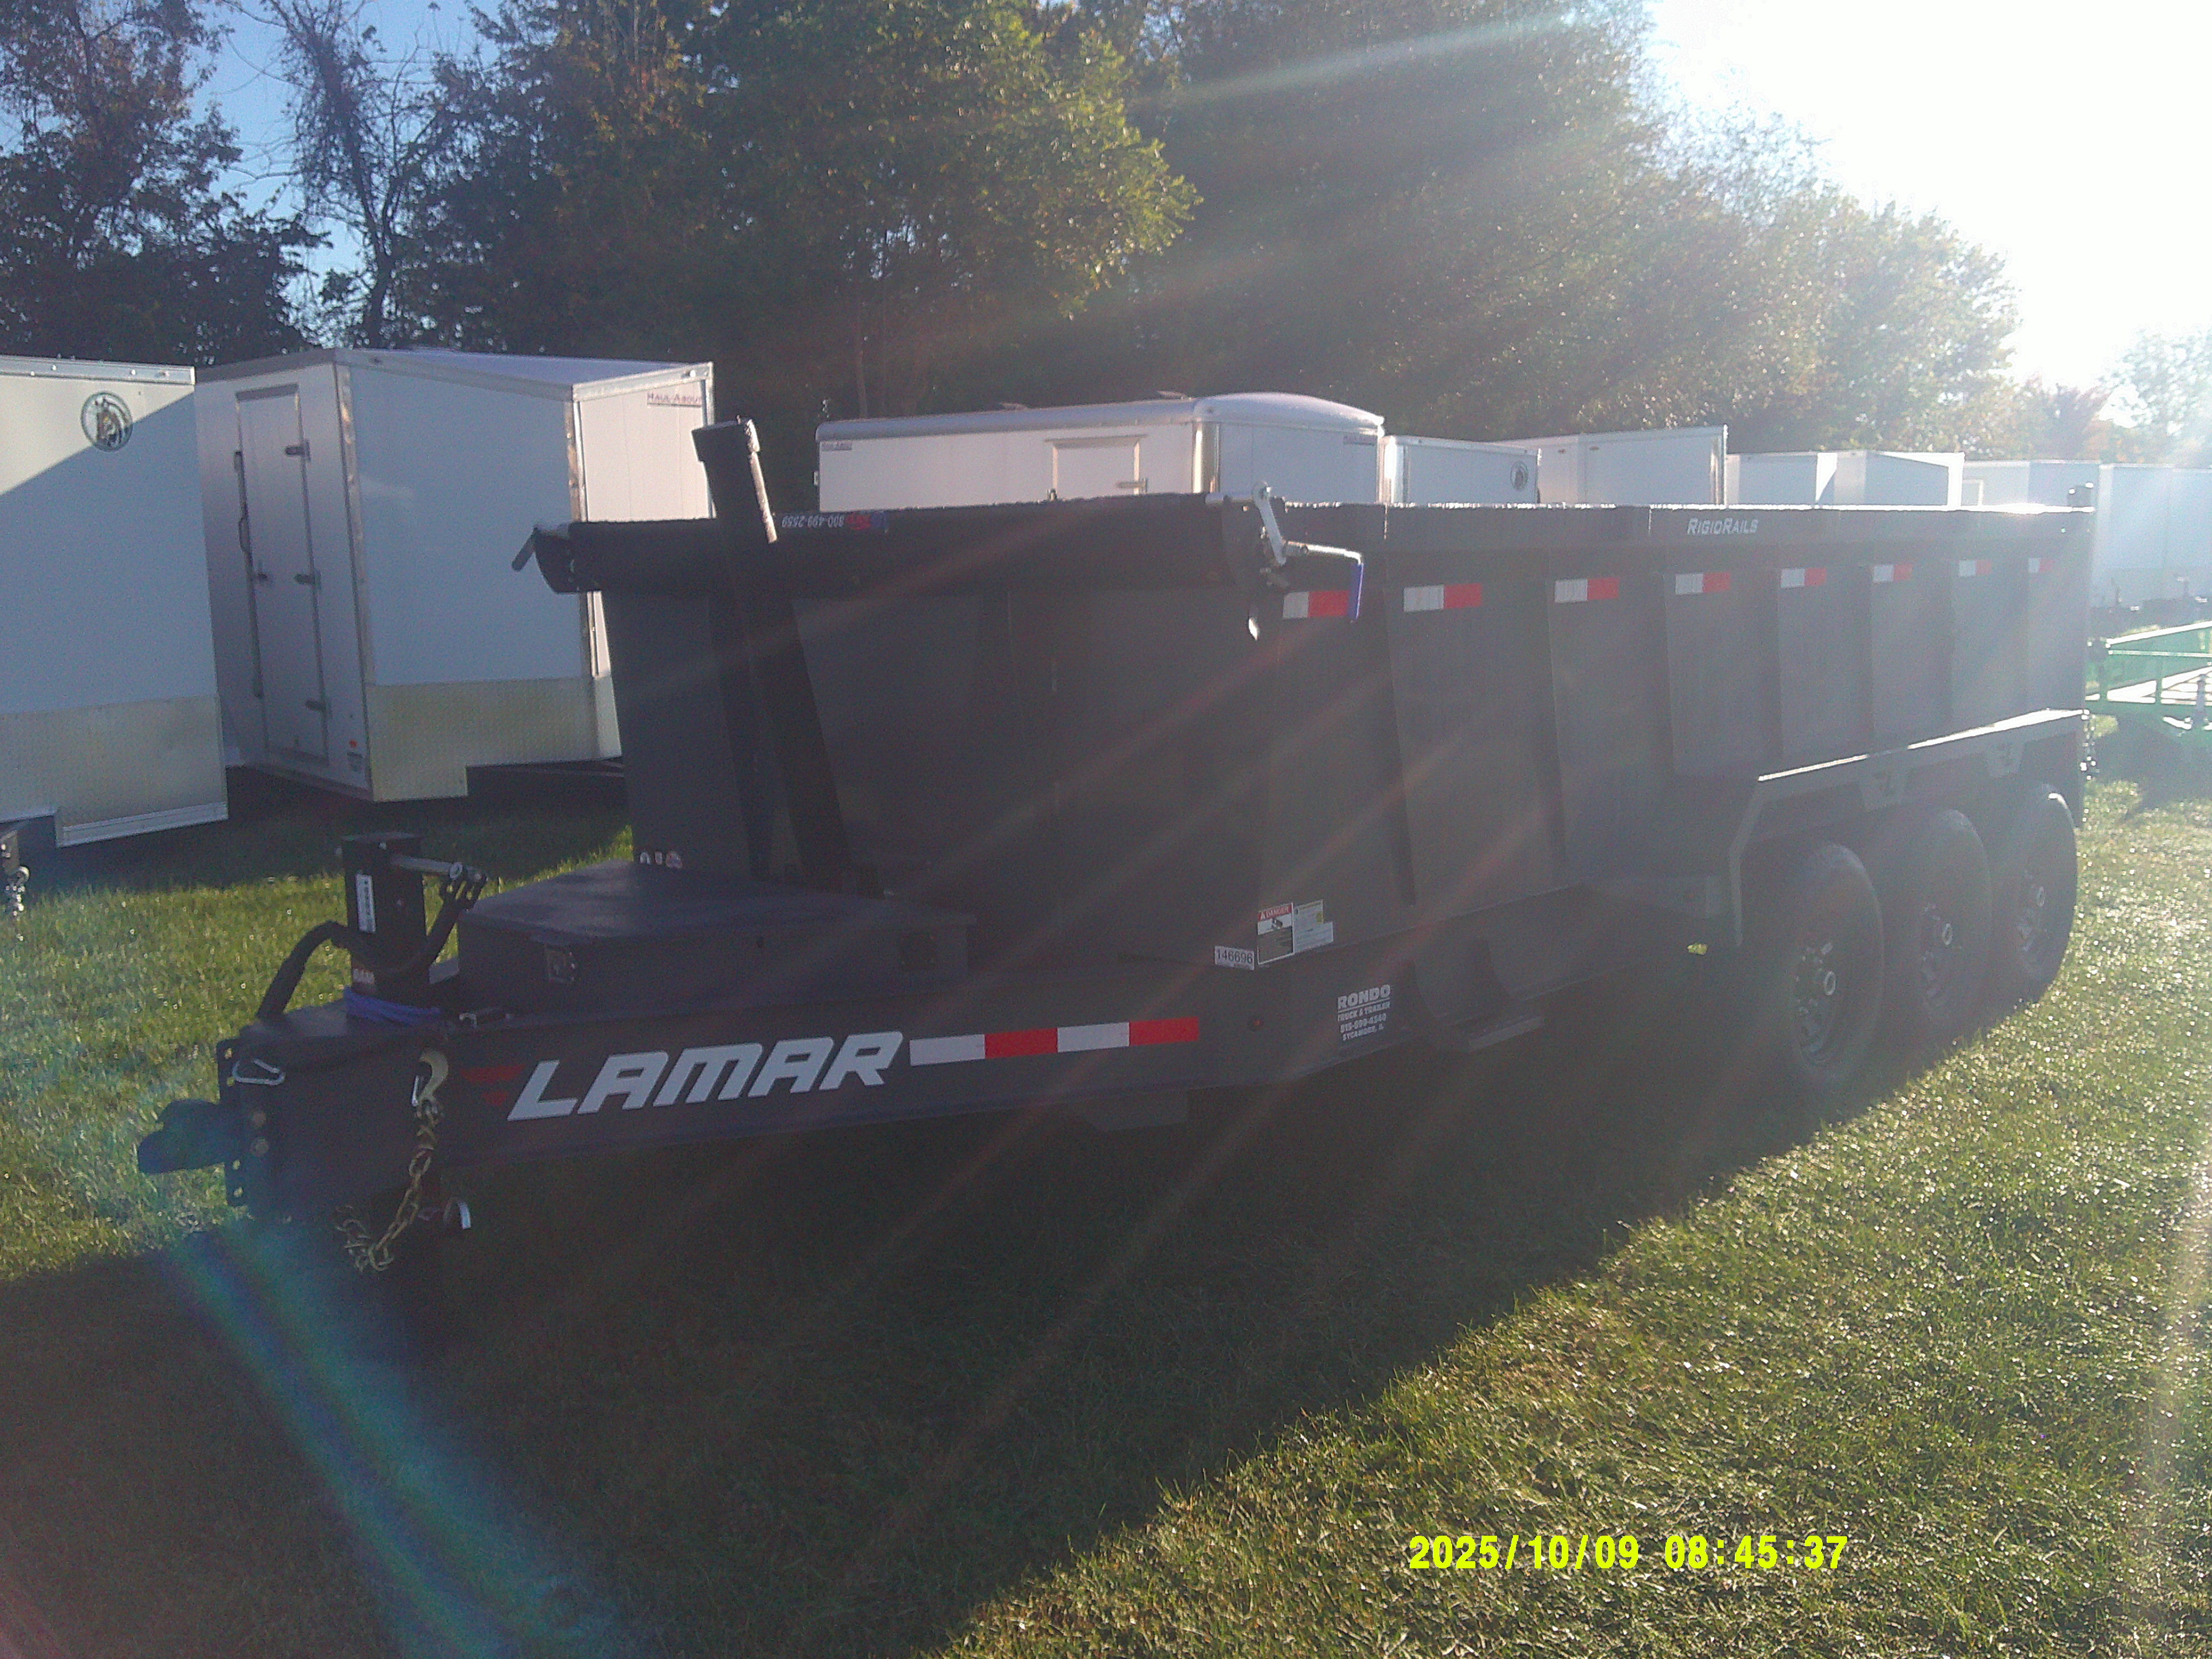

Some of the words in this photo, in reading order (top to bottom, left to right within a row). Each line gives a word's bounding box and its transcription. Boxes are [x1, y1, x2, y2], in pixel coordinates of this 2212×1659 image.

[1266, 906, 1289, 918] DANGER
[1217, 949, 1253, 964] 146696
[1337, 984, 1391, 1010] RONDO
[1337, 1010, 1358, 1022] TRUCK
[1364, 1001, 1390, 1015] TRAILER
[507, 1030, 904, 1122] LAMAR
